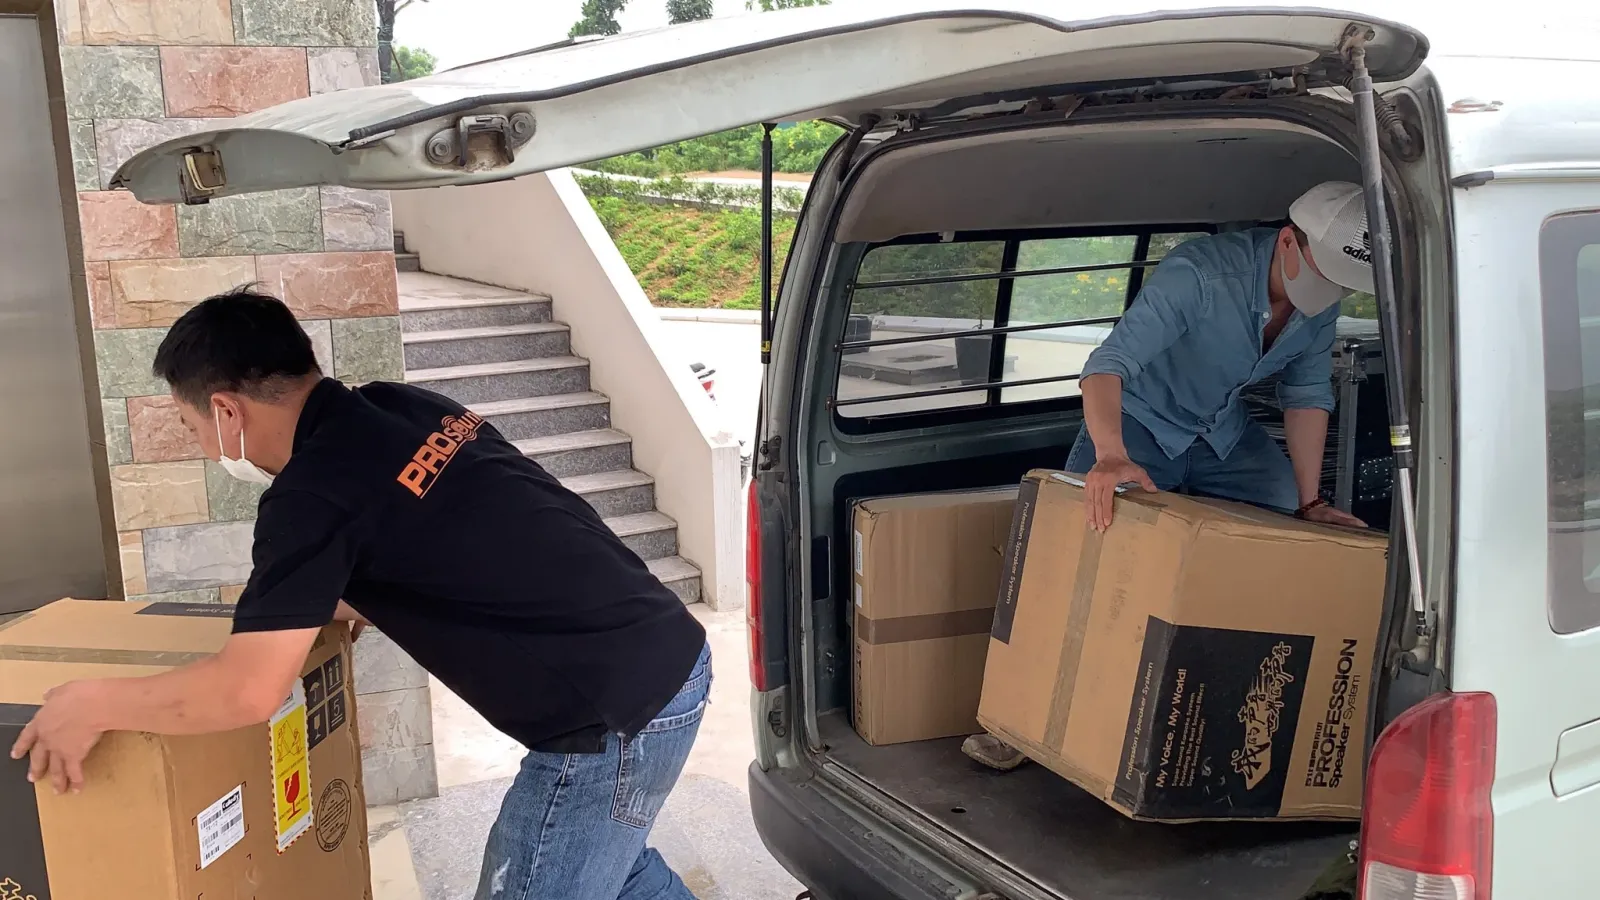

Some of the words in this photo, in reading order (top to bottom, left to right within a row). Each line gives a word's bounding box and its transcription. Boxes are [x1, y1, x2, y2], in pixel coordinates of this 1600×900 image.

[1343, 246, 1372, 263] adid
[1018, 501, 1030, 540] Profession
[1011, 541, 1022, 575] Speaker
[1005, 576, 1016, 605] System
[1172, 668, 1187, 705] World!
[1168, 708, 1181, 727] My
[1186, 692, 1196, 716] System
[1312, 638, 1358, 788] PROFESSION
[1125, 737, 1139, 781] Profession
[1134, 698, 1147, 736] Speaker
[1142, 661, 1154, 695] System
[1180, 717, 1190, 745] Karaoke
[1329, 723, 1351, 789] Speaker
[1343, 674, 1361, 720] System
[1160, 729, 1176, 769] Voice,
[1175, 745, 1185, 767] Sound
[1155, 769, 1168, 788] My
[1171, 767, 1180, 787] Super
